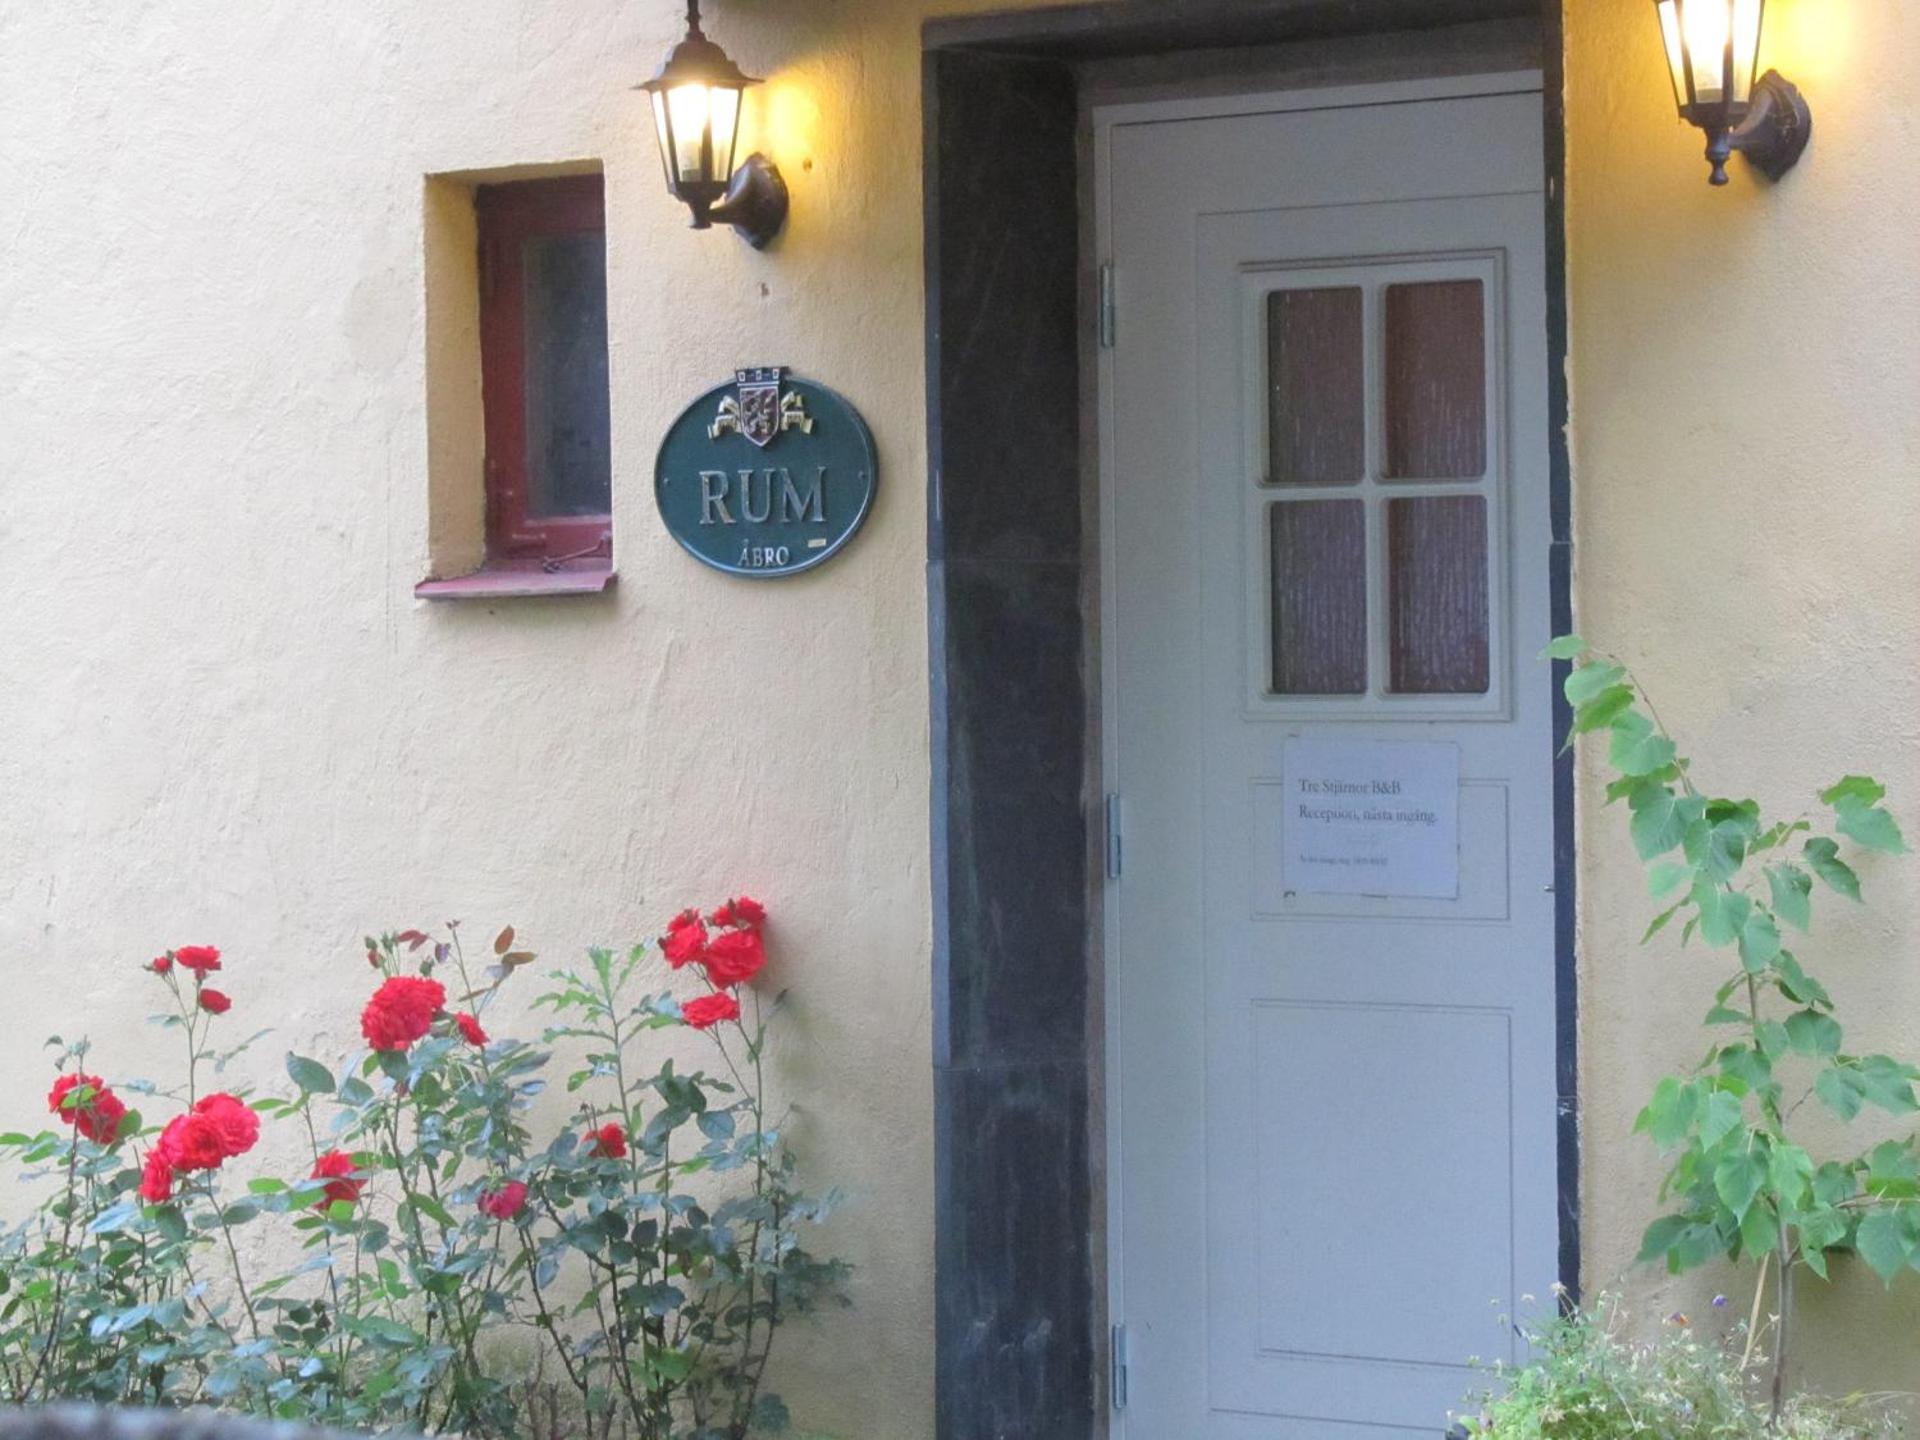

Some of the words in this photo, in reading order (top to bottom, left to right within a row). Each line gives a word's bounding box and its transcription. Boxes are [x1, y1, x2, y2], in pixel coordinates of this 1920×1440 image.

[699, 466, 827, 524] RUM
[738, 539, 790, 567] ÅBRO
[1299, 778, 1320, 793] Tre
[1372, 779, 1401, 795] B&B
